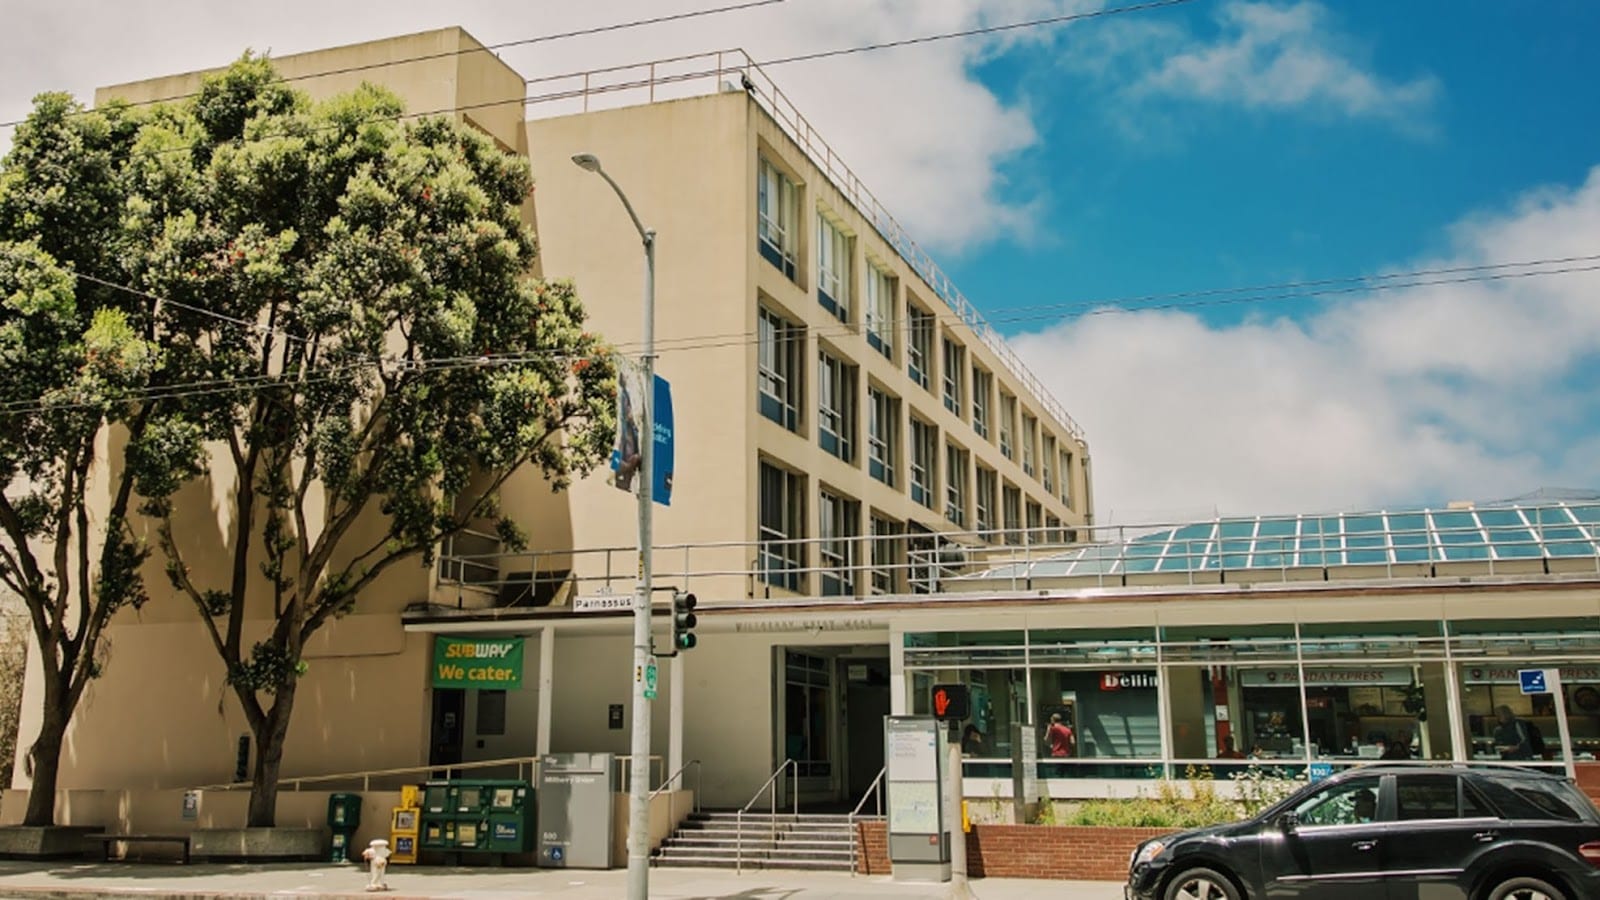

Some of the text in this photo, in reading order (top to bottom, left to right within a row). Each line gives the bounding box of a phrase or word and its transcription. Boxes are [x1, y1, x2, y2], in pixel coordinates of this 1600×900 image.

[575, 598, 632, 609] Parnassus
[445, 643, 512, 659] SUBWAY
[438, 664, 517, 681] We cater.
[1330, 670, 1385, 681] EXPRESS
[1488, 667, 1598, 679] PAN PRESS
